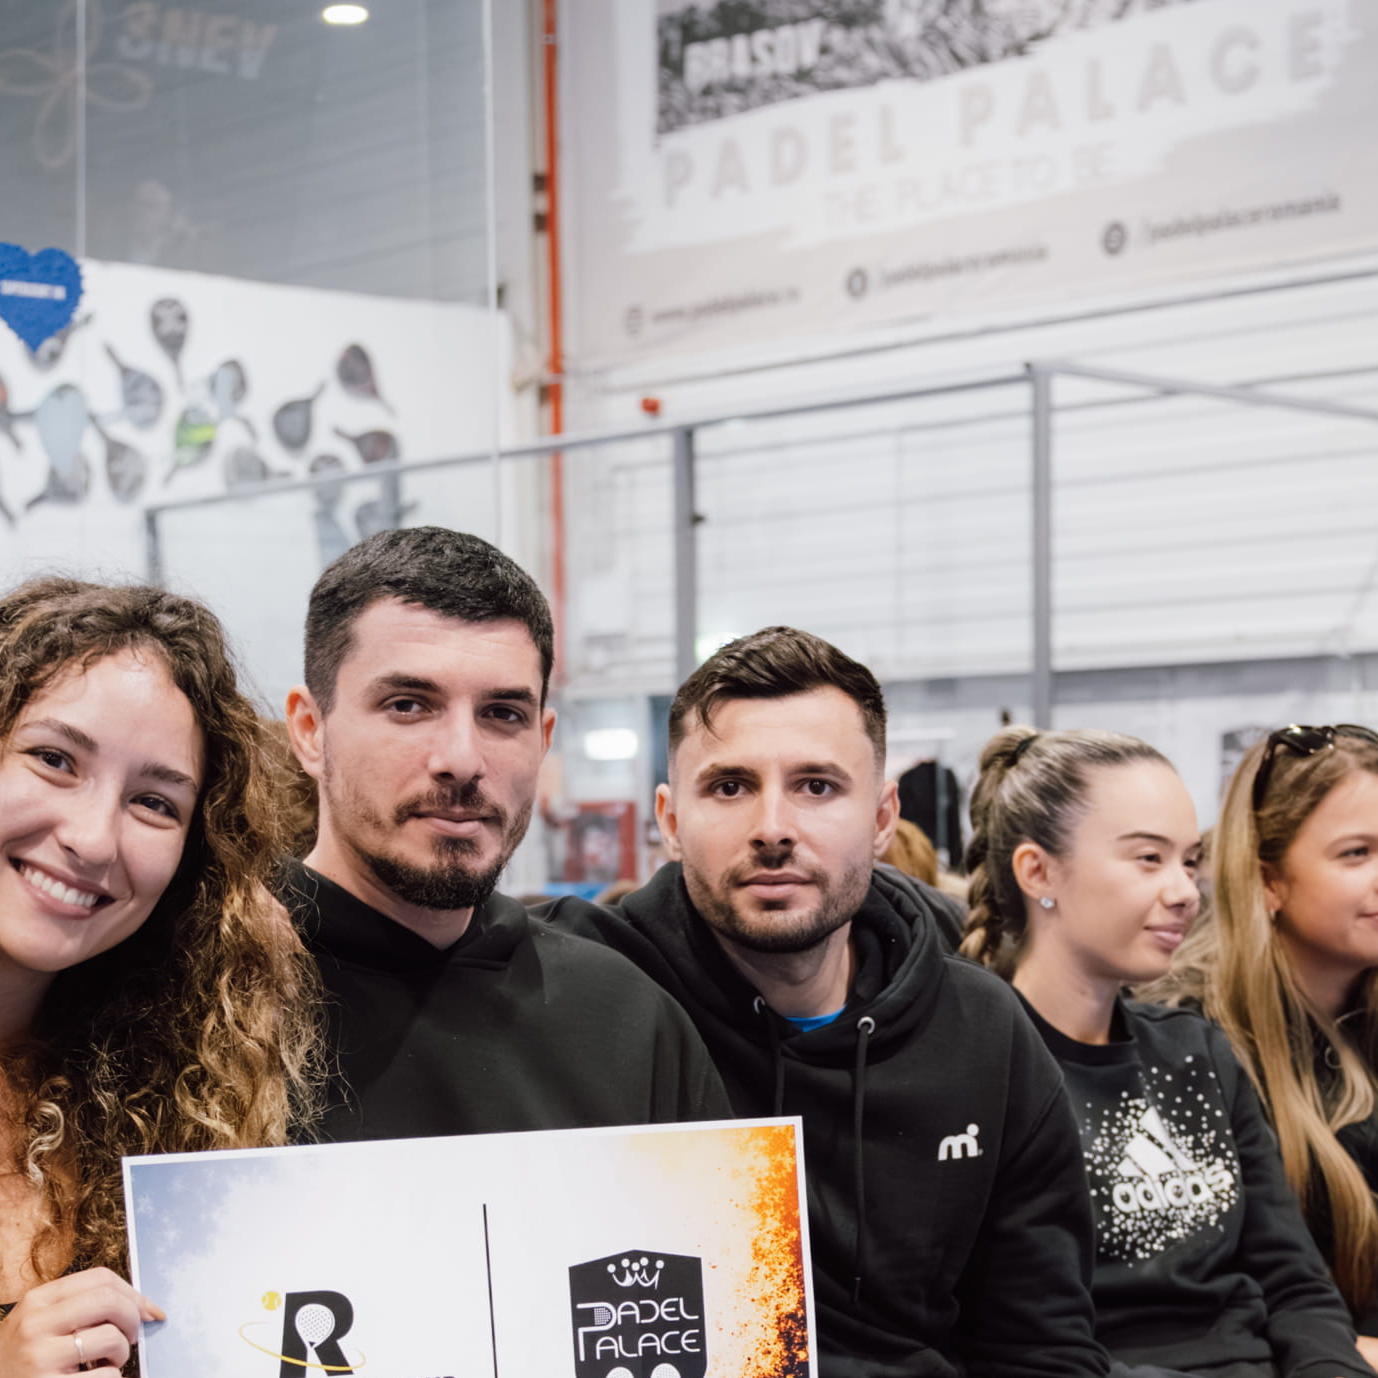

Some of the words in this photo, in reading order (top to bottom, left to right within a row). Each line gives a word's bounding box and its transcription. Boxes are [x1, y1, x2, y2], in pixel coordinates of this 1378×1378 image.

[663, 104, 906, 208] PADEL
[958, 12, 1331, 148] PALACE
[1112, 1161, 1235, 1213] adidas
[576, 1297, 700, 1333] PADEL
[577, 1328, 701, 1362] PALACE
